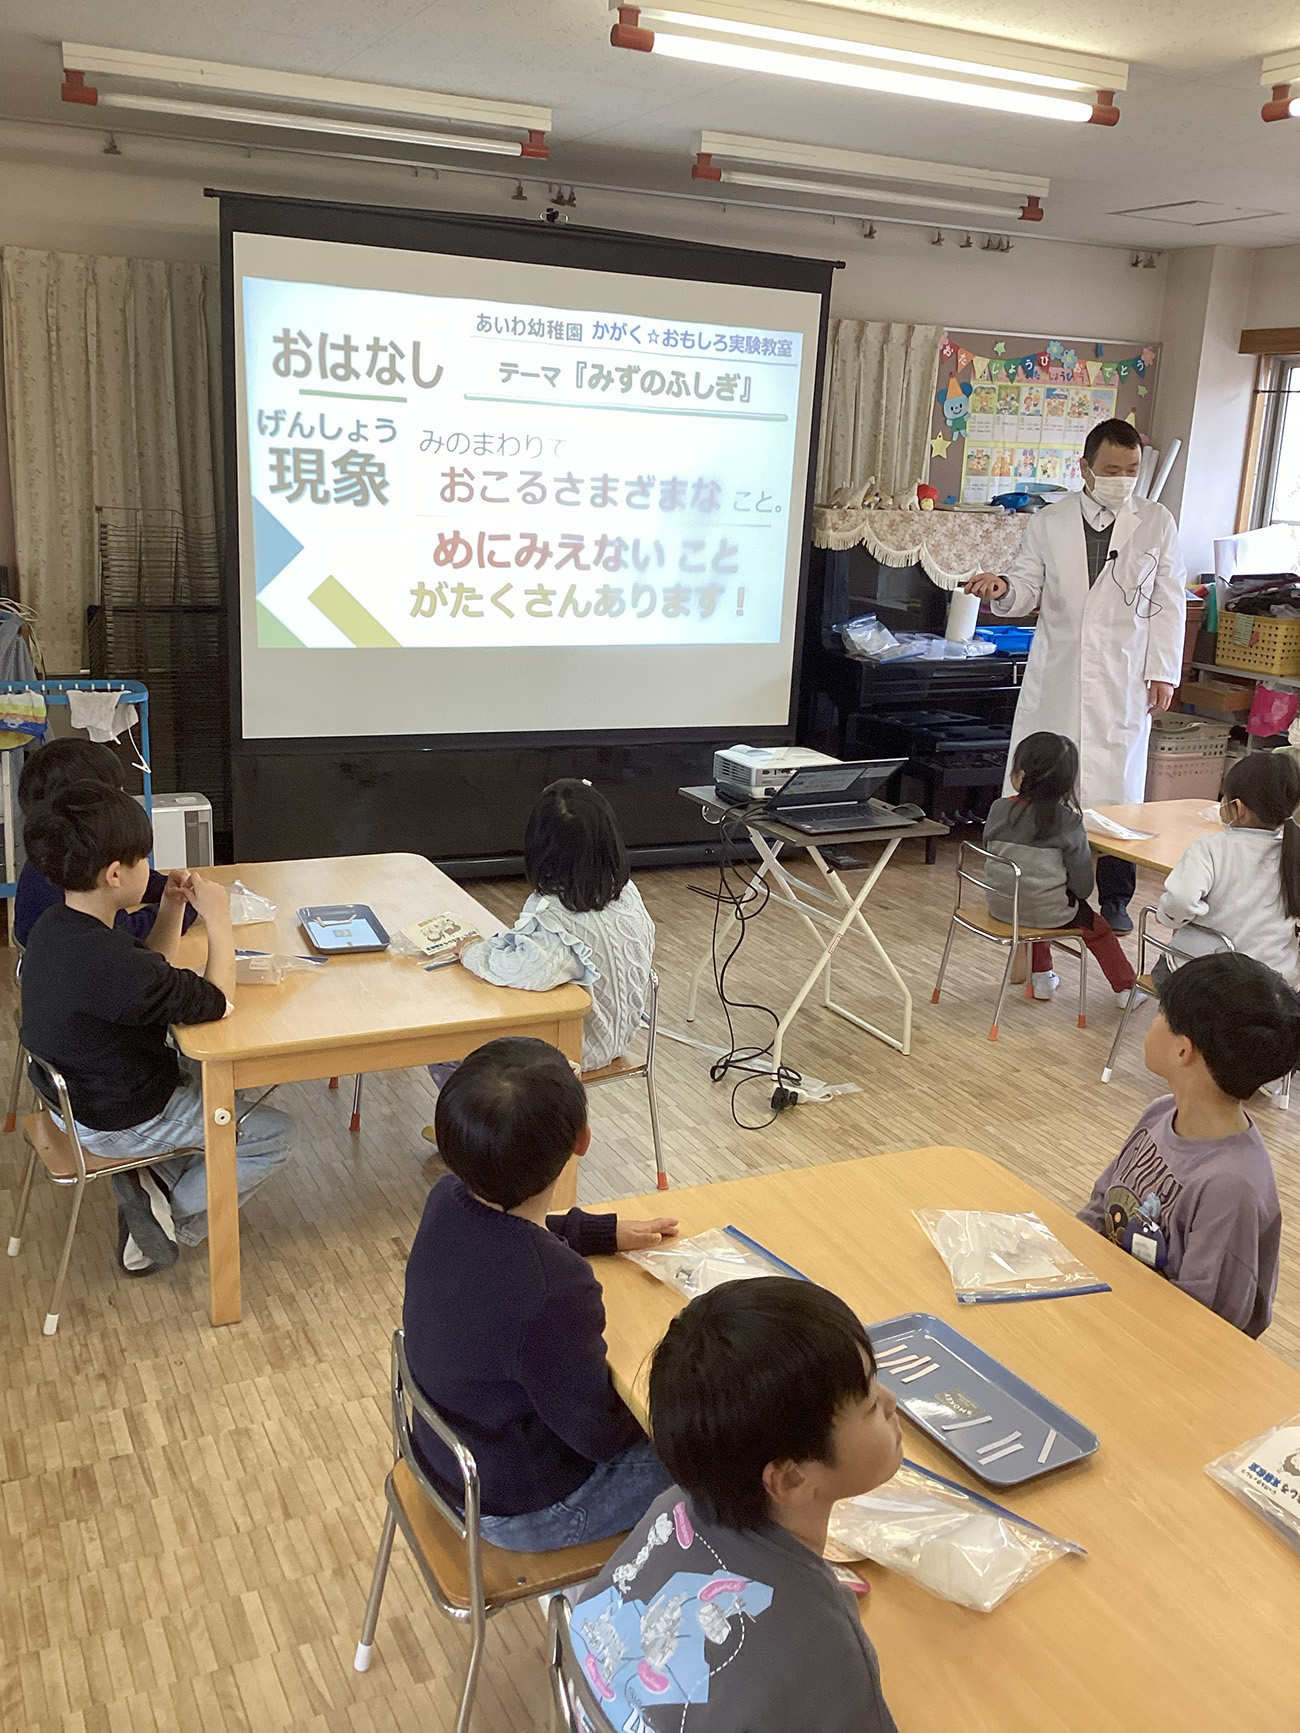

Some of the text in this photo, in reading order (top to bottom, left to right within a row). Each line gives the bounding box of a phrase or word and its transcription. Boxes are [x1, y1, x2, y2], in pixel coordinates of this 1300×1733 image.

[476, 313, 793, 358] あいわ幼稚園 かがく☆おもしろ実験教室
[272, 327, 444, 389] おはなし
[942, 344, 1049, 375] おたじょうび
[499, 361, 752, 403] テーマ『みずのふしぎ』
[257, 409, 397, 443] げんしょう
[269, 447, 390, 507] 現象
[439, 466, 782, 513] おこるさまざまな こと。
[433, 530, 739, 574] めにみえない こと
